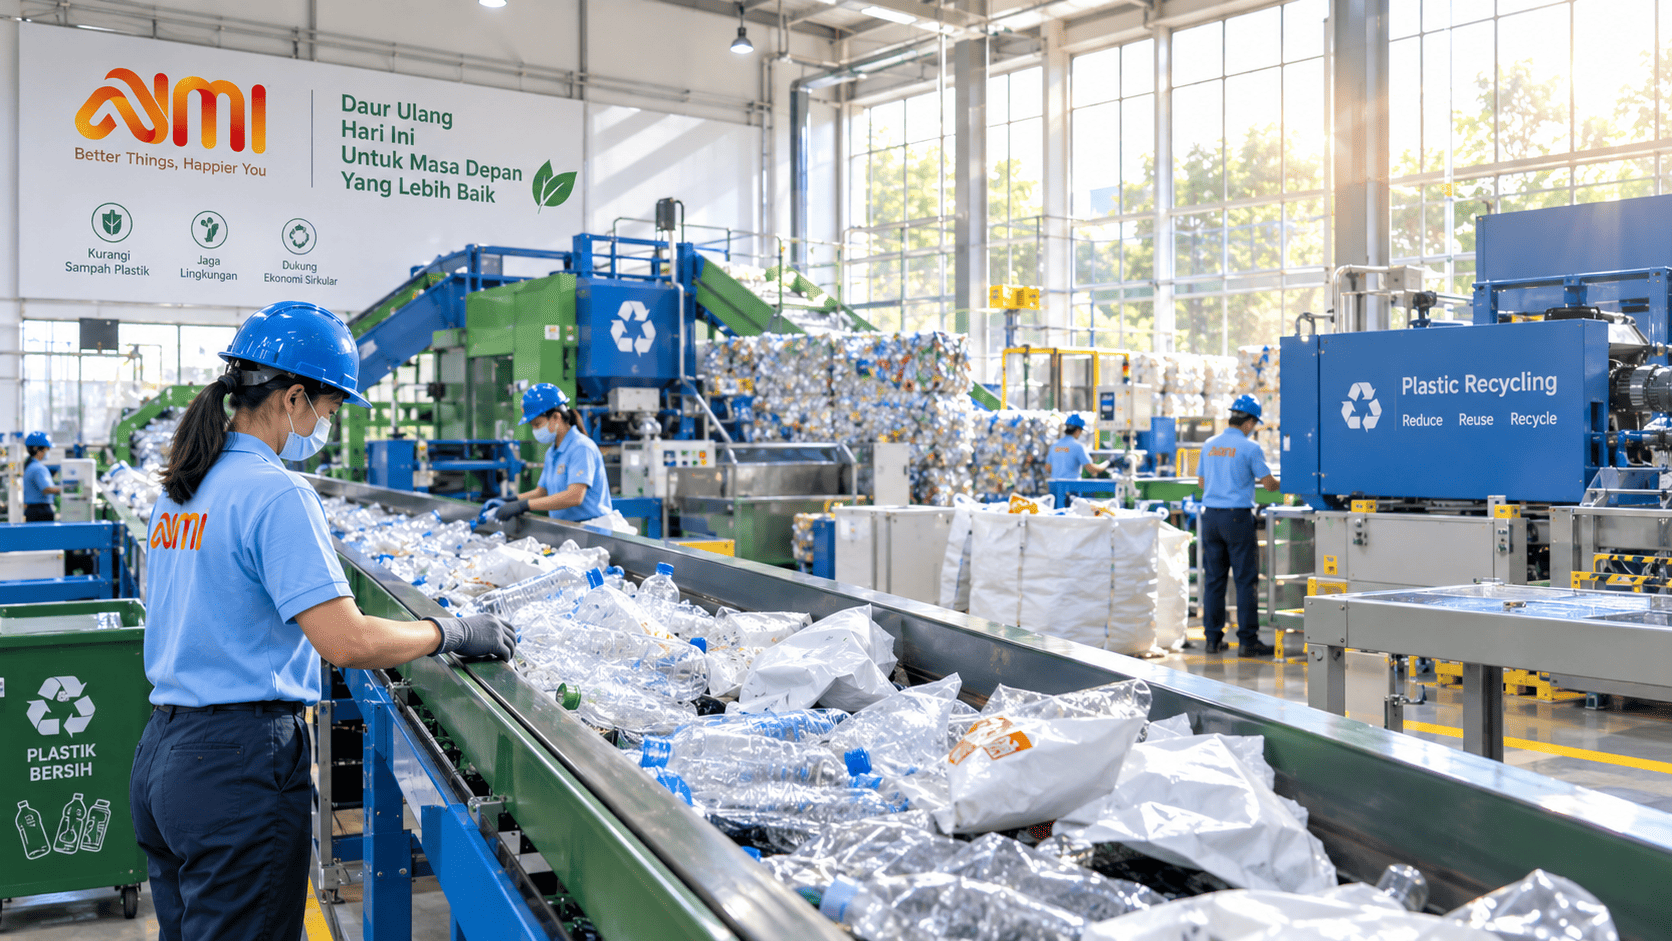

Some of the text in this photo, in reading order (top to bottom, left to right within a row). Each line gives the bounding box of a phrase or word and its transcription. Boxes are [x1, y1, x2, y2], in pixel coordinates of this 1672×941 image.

[341, 93, 453, 130] Daur Ulang
[341, 119, 415, 146] Hari Ini
[74, 147, 267, 177] Better Things, Happier You
[341, 145, 523, 182] Untuk Masa Depan
[341, 170, 496, 203] Yang Lebih Baik
[87, 247, 131, 262] Kurangi
[197, 255, 221, 267] Jaga
[64, 261, 150, 277] Sampah Plastik
[180, 267, 238, 282] Lingkungan
[282, 260, 318, 273] Dukung
[263, 272, 338, 286] Ekonomi Sirkular
[1402, 371, 1558, 398] Plastic Recycling
[1402, 411, 1558, 429] Reduce Reuse Recycle
[27, 743, 97, 763] PLASTIK
[30, 761, 93, 782] BERSIH
